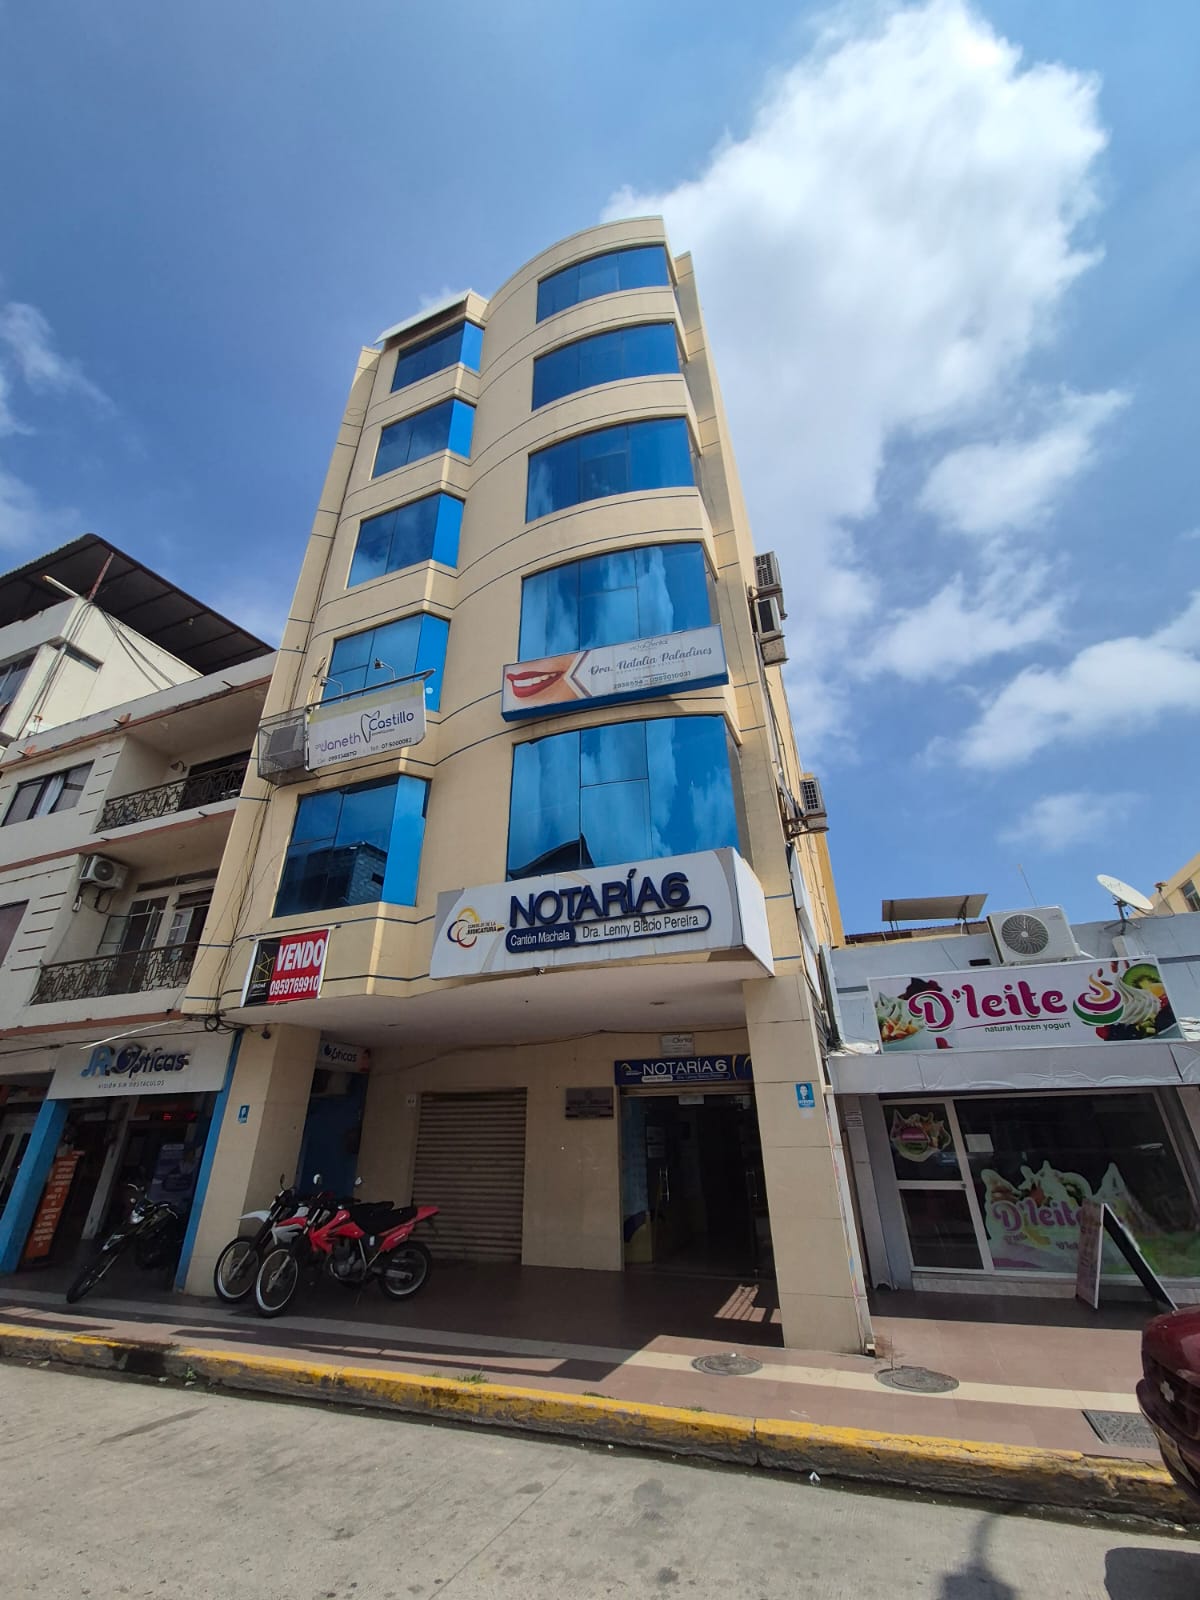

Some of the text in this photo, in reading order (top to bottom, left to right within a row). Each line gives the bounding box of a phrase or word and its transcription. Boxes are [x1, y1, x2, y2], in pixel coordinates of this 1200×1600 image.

[588, 664, 615, 676] Dra.
[617, 656, 657, 671] Natalia
[660, 646, 713, 663] Paladines
[369, 710, 415, 731] Castillo
[320, 732, 361, 752] Janeth
[538, 929, 571, 945] Machala
[582, 924, 601, 939] Dra.
[603, 919, 631, 938] Lenny
[633, 917, 662, 935] Blacio
[664, 913, 699, 930] Pereira
[277, 938, 325, 972] VENDO
[908, 980, 1068, 1033] D'leite
[984, 1021, 1072, 1033] natural frozen yogurt
[642, 1057, 728, 1076] NOTARÍA 6
